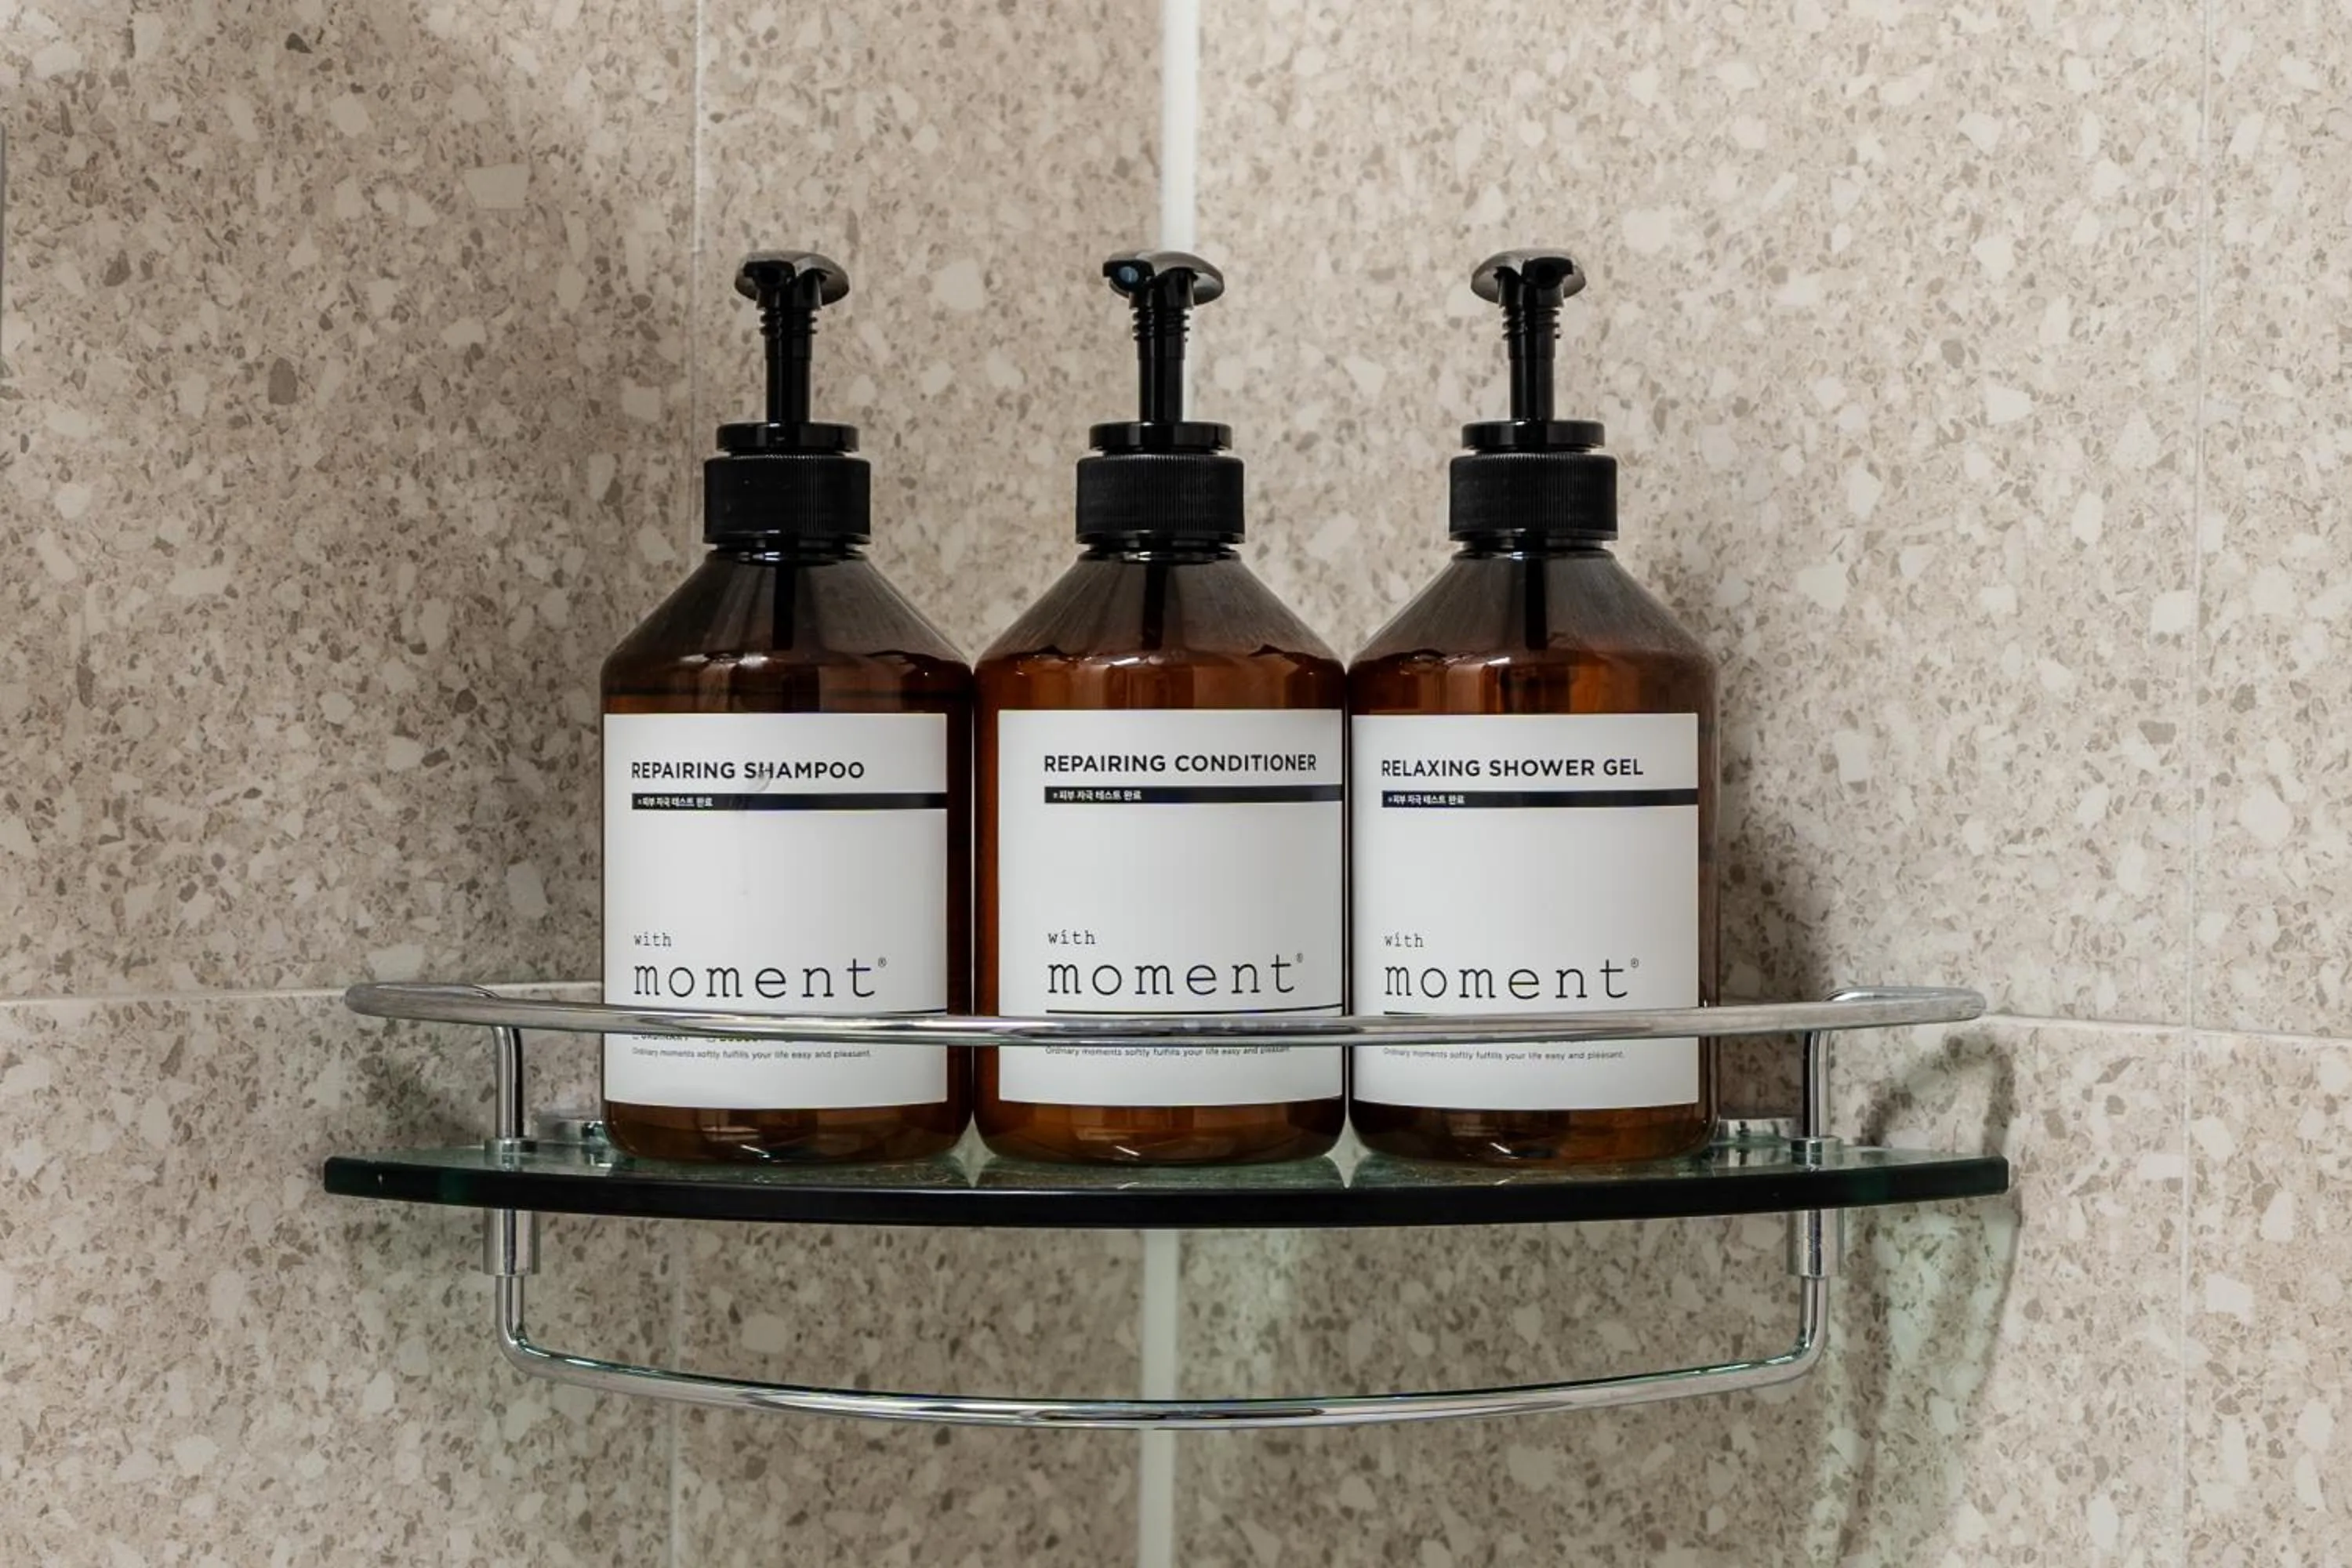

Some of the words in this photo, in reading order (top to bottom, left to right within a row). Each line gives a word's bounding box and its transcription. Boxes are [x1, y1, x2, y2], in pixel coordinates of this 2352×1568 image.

[631, 761, 735, 779] REPAIRING
[744, 761, 865, 779] SHAMPOO
[1044, 755, 1166, 772] REPAIRING
[1175, 754, 1317, 772] CONDITIONER
[1381, 760, 1481, 777] RELAXING
[1489, 759, 1595, 777] SHOWER
[1603, 758, 1644, 775] GEL
[633, 932, 672, 947] with
[1047, 930, 1096, 946] with
[1384, 932, 1425, 948] with
